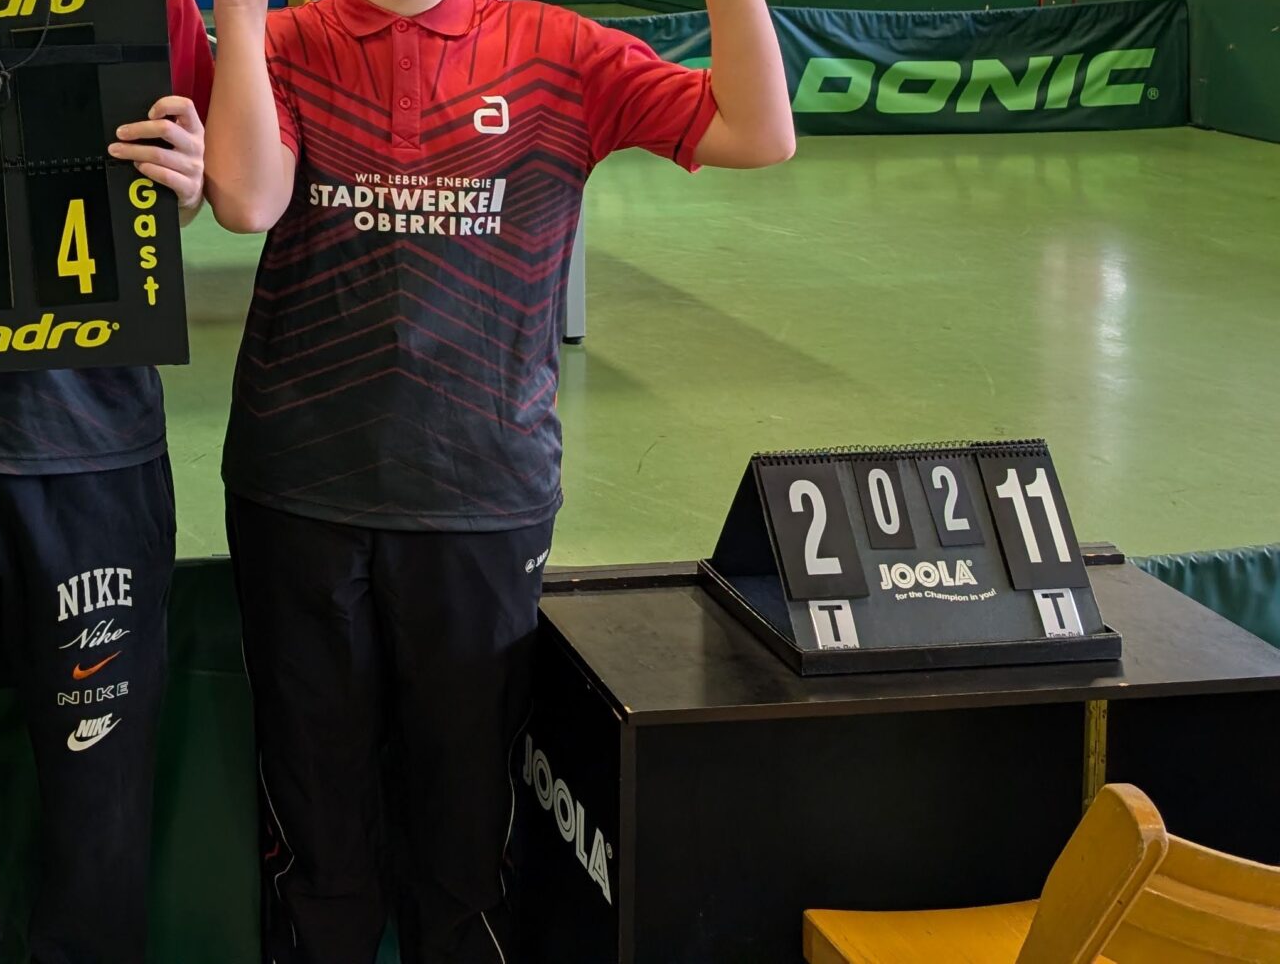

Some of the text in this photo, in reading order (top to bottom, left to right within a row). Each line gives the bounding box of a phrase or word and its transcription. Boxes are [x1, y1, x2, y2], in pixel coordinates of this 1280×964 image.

[791, 48, 1156, 114] DONIC
[355, 173, 492, 189] WIR LEBEN ENERGIE
[354, 211, 501, 236] OBERKIRCH
[57, 199, 96, 294] 4
[788, 465, 1071, 575] 2 0 2 11
[879, 559, 978, 590] JOOLA
[57, 567, 133, 622] NIKE
[895, 588, 997, 602] for the Champion in you!
[1041, 593, 1066, 629] T
[58, 618, 131, 650] Nike
[818, 605, 843, 642] T
[57, 681, 129, 706] NIKE
[75, 713, 113, 738] NIKE
[522, 733, 612, 905] JOOLA
